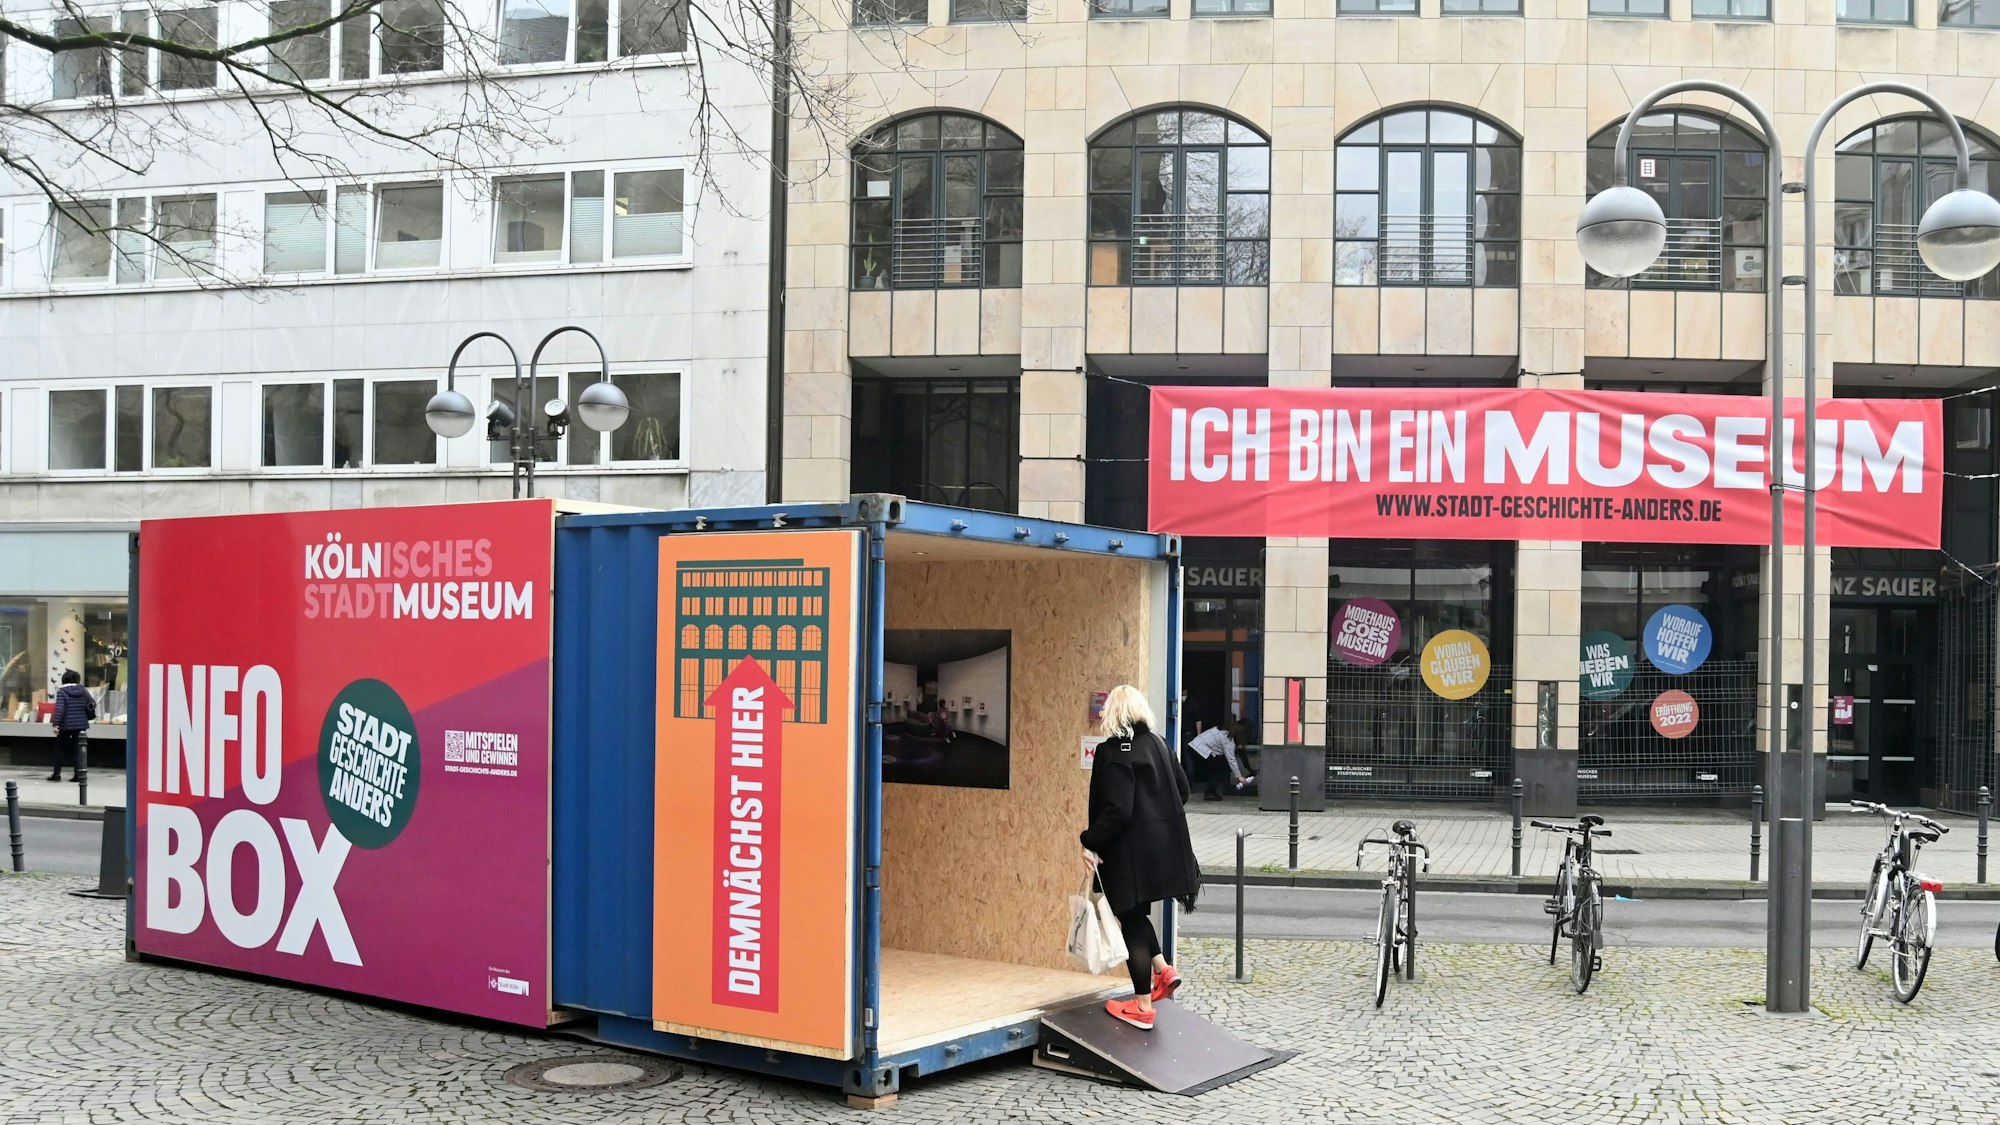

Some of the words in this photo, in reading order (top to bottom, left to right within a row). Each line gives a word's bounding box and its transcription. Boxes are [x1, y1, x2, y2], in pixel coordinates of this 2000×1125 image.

[1170, 407, 1271, 482] ICH
[1289, 408, 1372, 483] BIN
[1388, 409, 1467, 484] EIN
[1483, 410, 1924, 494] MUSEUM
[1375, 494, 1722, 522] WWW.STADT-GESCHICHTE-ANDERS.DE
[304, 531, 493, 580] KÖLNISCHES
[1187, 566, 1265, 588] SAUER
[1861, 576, 1937, 597] SAUER
[303, 581, 534, 621] STADTMUSEUM
[1344, 604, 1396, 632] MODEHAUS
[1661, 613, 1703, 637] WORAUF
[1335, 631, 1388, 659] MUSEUM
[1341, 619, 1390, 645] GOES
[1656, 627, 1699, 653] HOFFEN
[1433, 641, 1473, 660] WORAN
[1585, 643, 1611, 660] WAS
[1656, 641, 1690, 664] WIR
[1430, 654, 1481, 676] GLAUBEN
[1440, 670, 1476, 688] WIR
[1589, 671, 1615, 688] WIR
[1655, 702, 1693, 718] ERÖFFNUNG
[1659, 712, 1692, 728] 2022
[147, 664, 283, 806] INFO
[337, 702, 413, 765] STADT
[731, 686, 765, 768] HIER
[465, 731, 518, 752] MITSPIELEN
[329, 731, 408, 800] GESCHICHTE
[465, 749, 480, 764] UND
[481, 750, 518, 766] GEWINNEN
[444, 765, 518, 777] STADT-GESCHICHTE-ANDERS.DE
[328, 766, 395, 829] ANDERS
[146, 802, 364, 967] BOX
[723, 775, 764, 996] DEMNÄCHST
